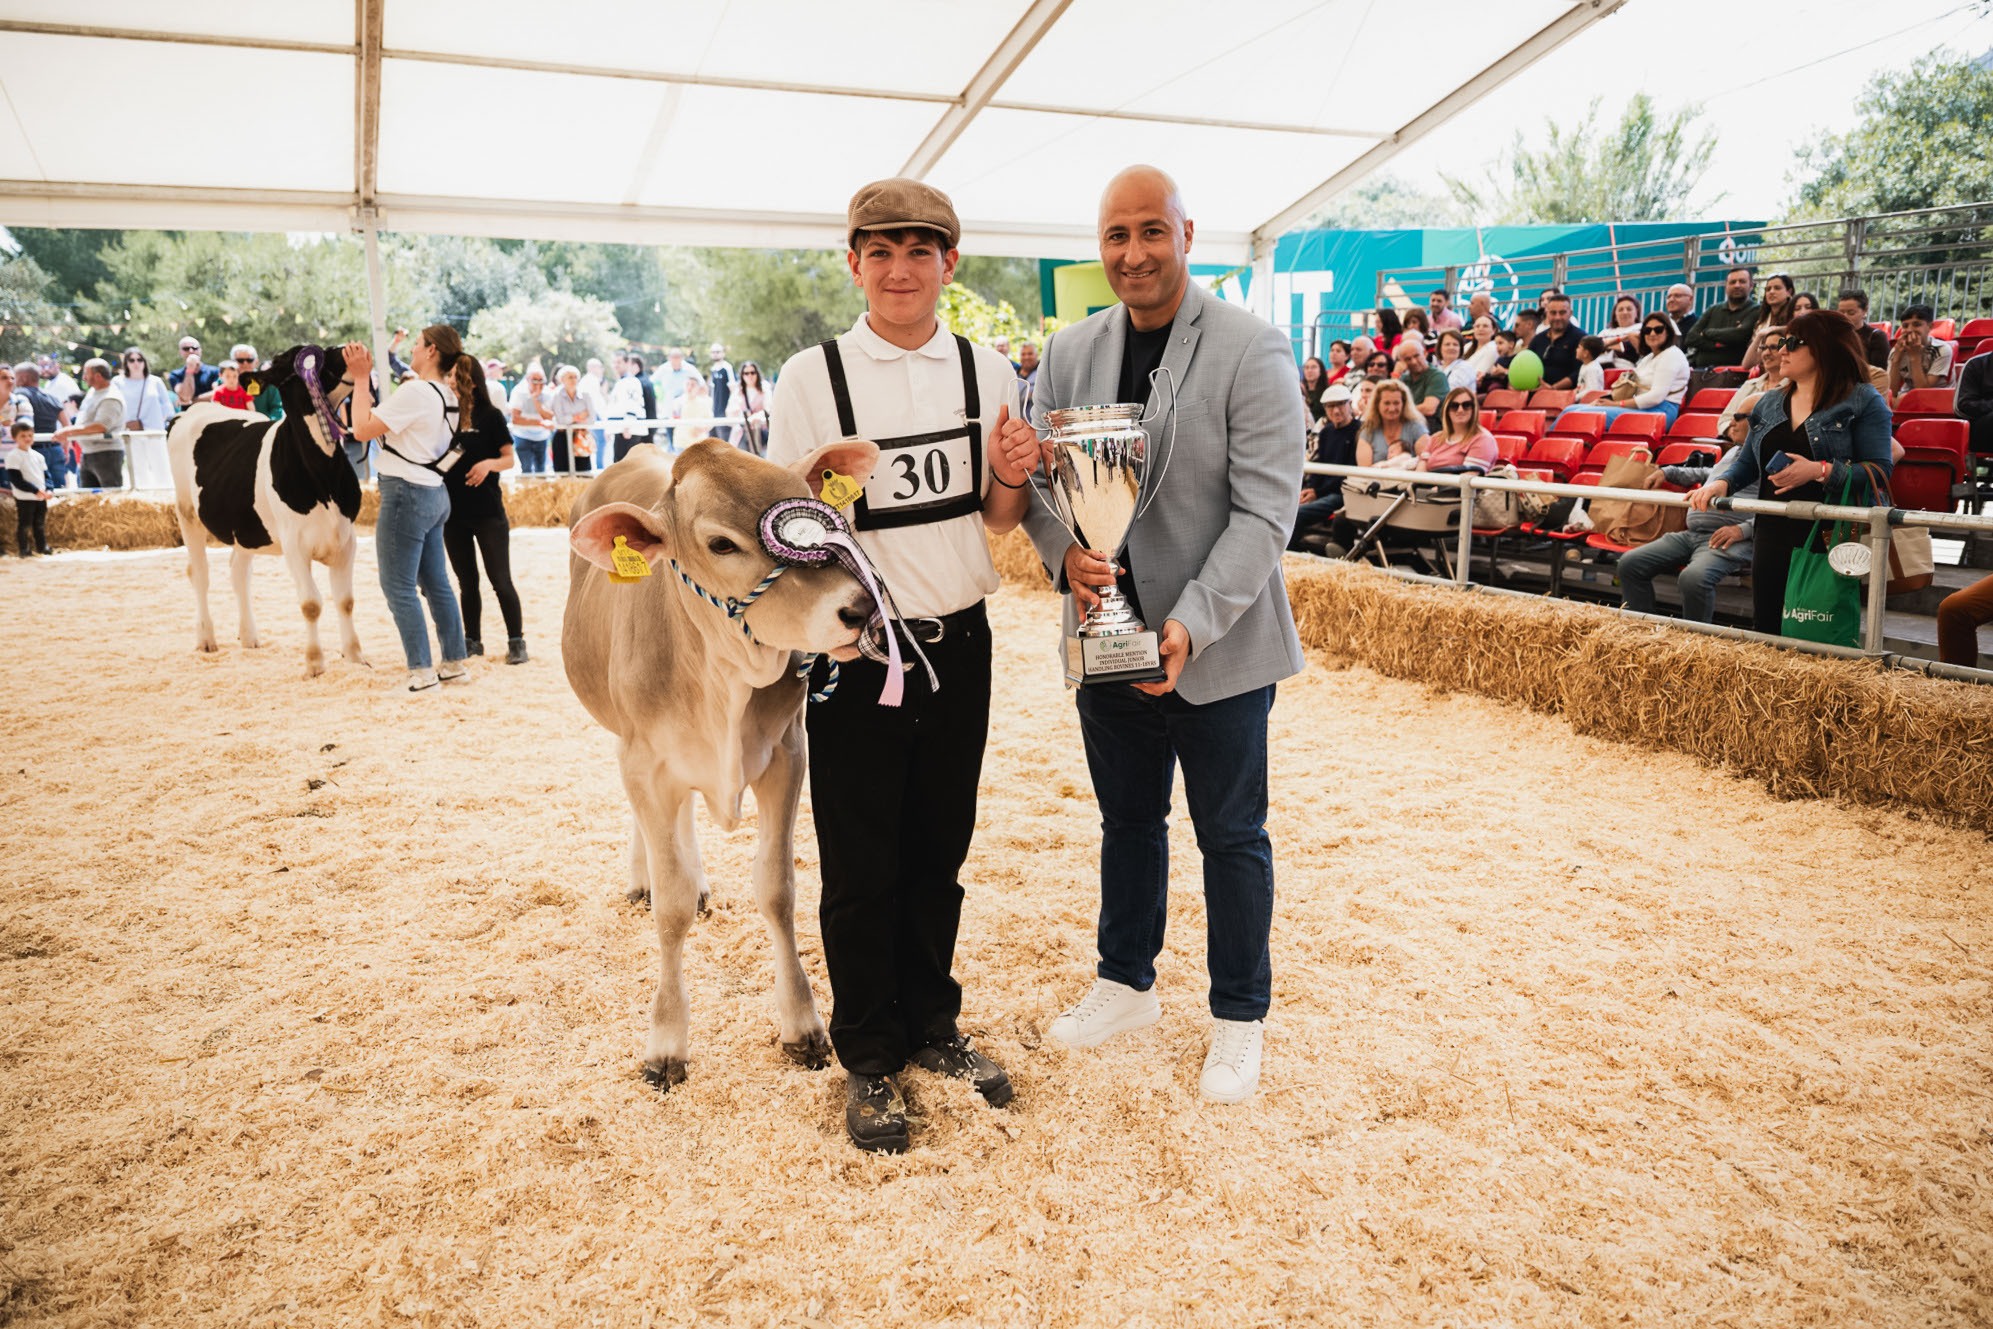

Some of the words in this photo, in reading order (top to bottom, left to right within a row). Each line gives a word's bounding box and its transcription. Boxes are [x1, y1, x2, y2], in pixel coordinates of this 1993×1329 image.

[890, 448, 950, 500] 30
[1791, 608, 1834, 623] AgriFair
[1113, 640, 1141, 650] AgriFair
[1095, 652, 1124, 660] HONORABLE
[1099, 658, 1127, 666] INDIVIDUAL
[1128, 656, 1145, 664] JUNIOR
[1088, 665, 1113, 673] HANDLING
